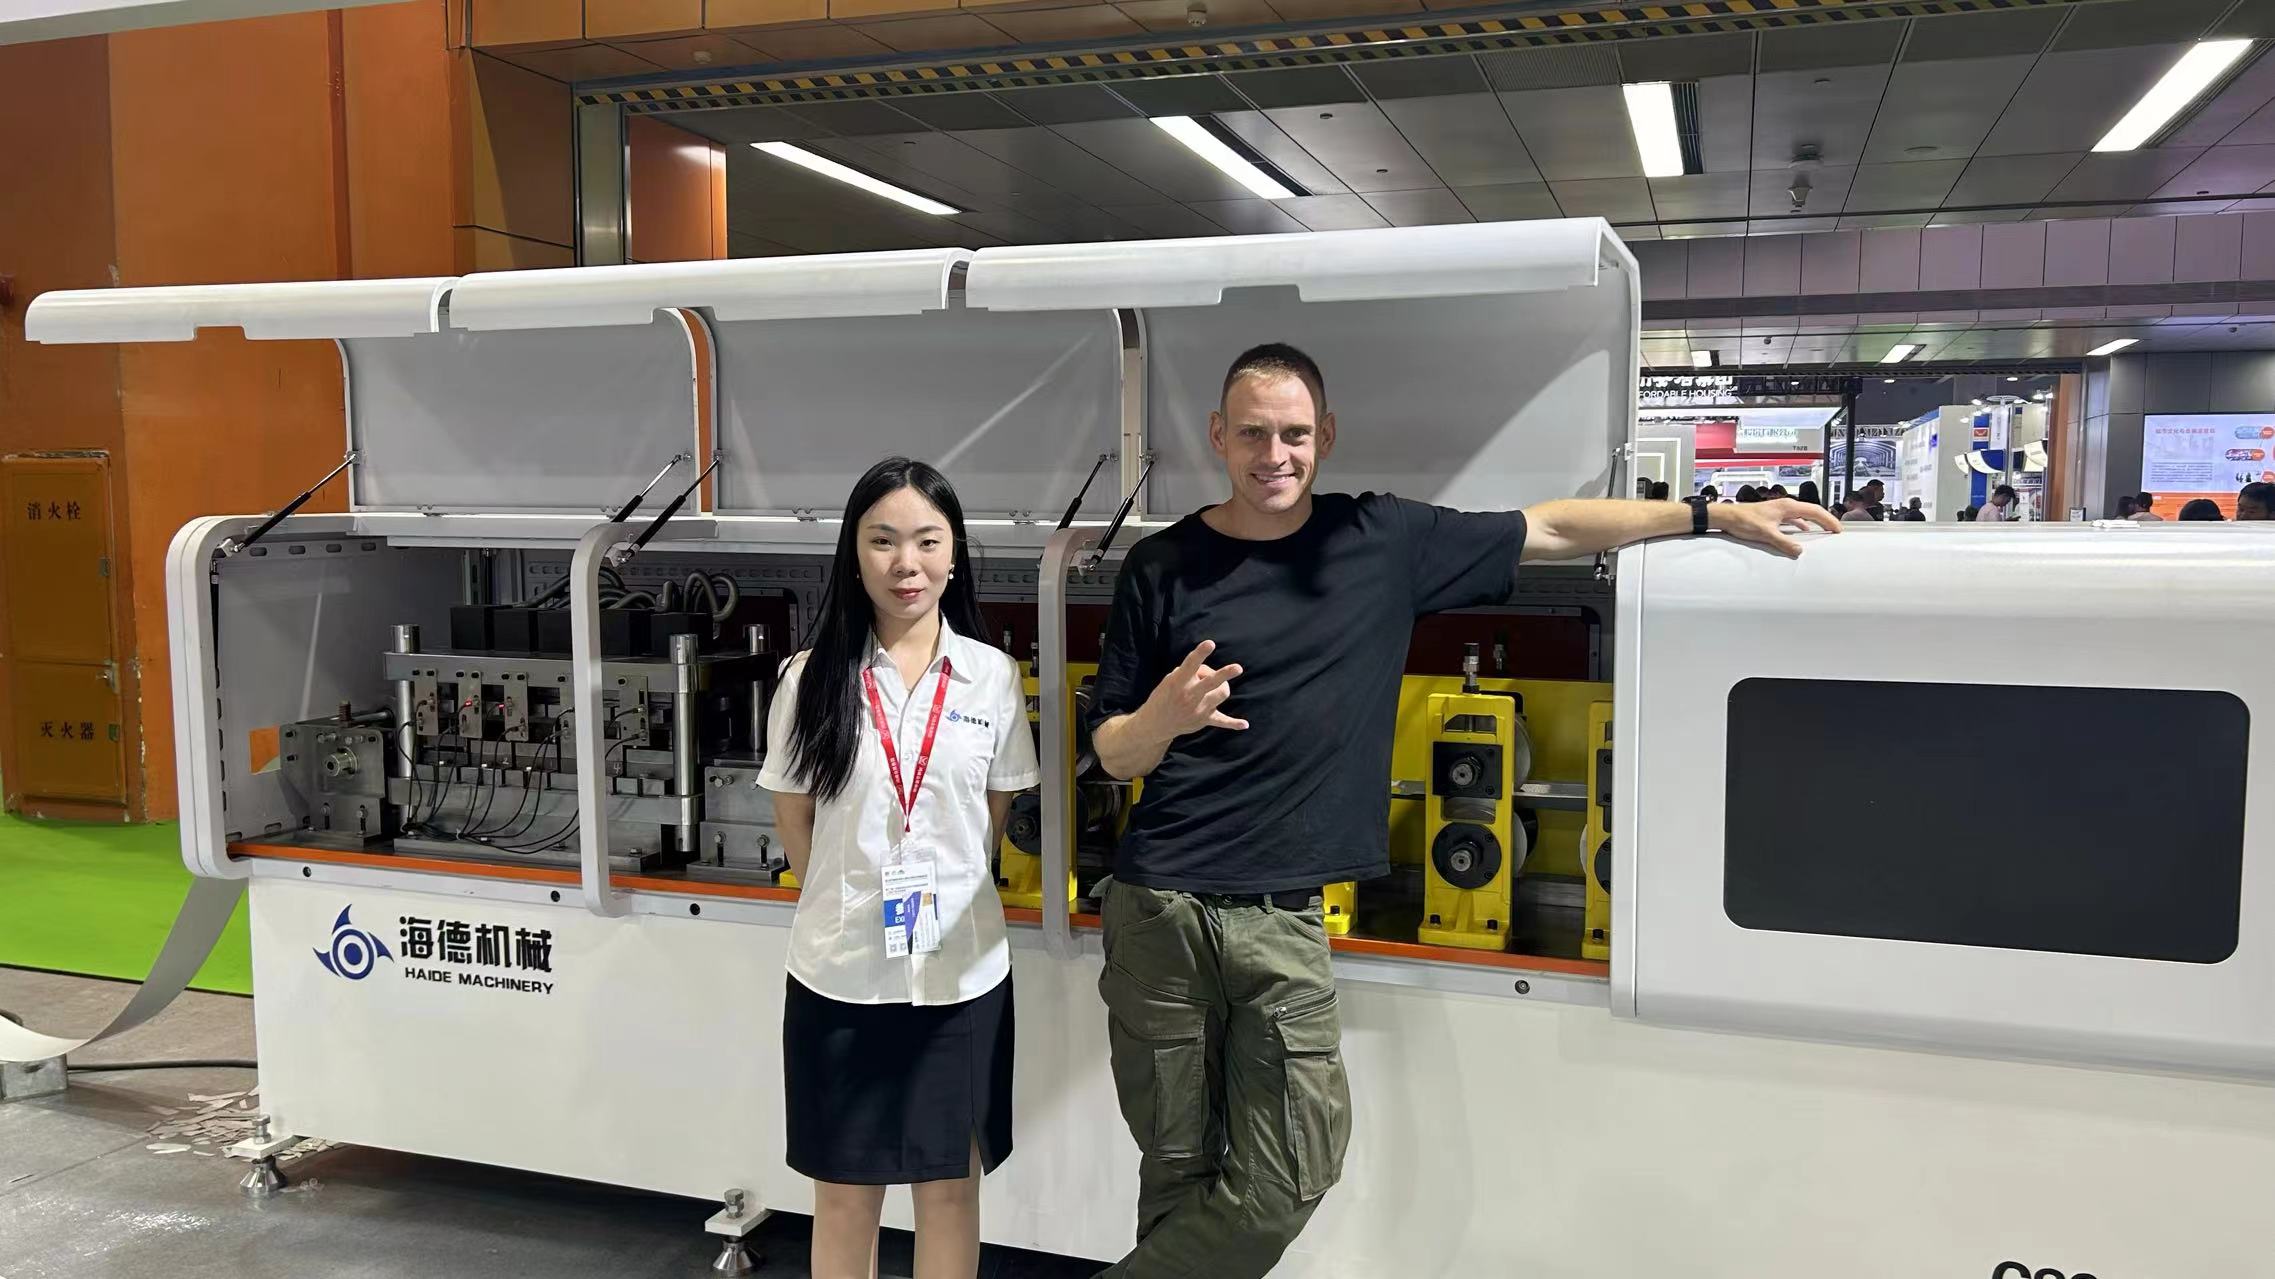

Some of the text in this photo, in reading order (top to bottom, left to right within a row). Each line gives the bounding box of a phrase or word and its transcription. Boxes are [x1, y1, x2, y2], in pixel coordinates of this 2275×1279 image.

[1689, 389, 1732, 398] HOUSING
[27, 501, 81, 520] 消火栓
[41, 721, 94, 740] 灭火器
[400, 916, 552, 973] 海德机械
[405, 966, 554, 994] HAIDE MACHINERY
